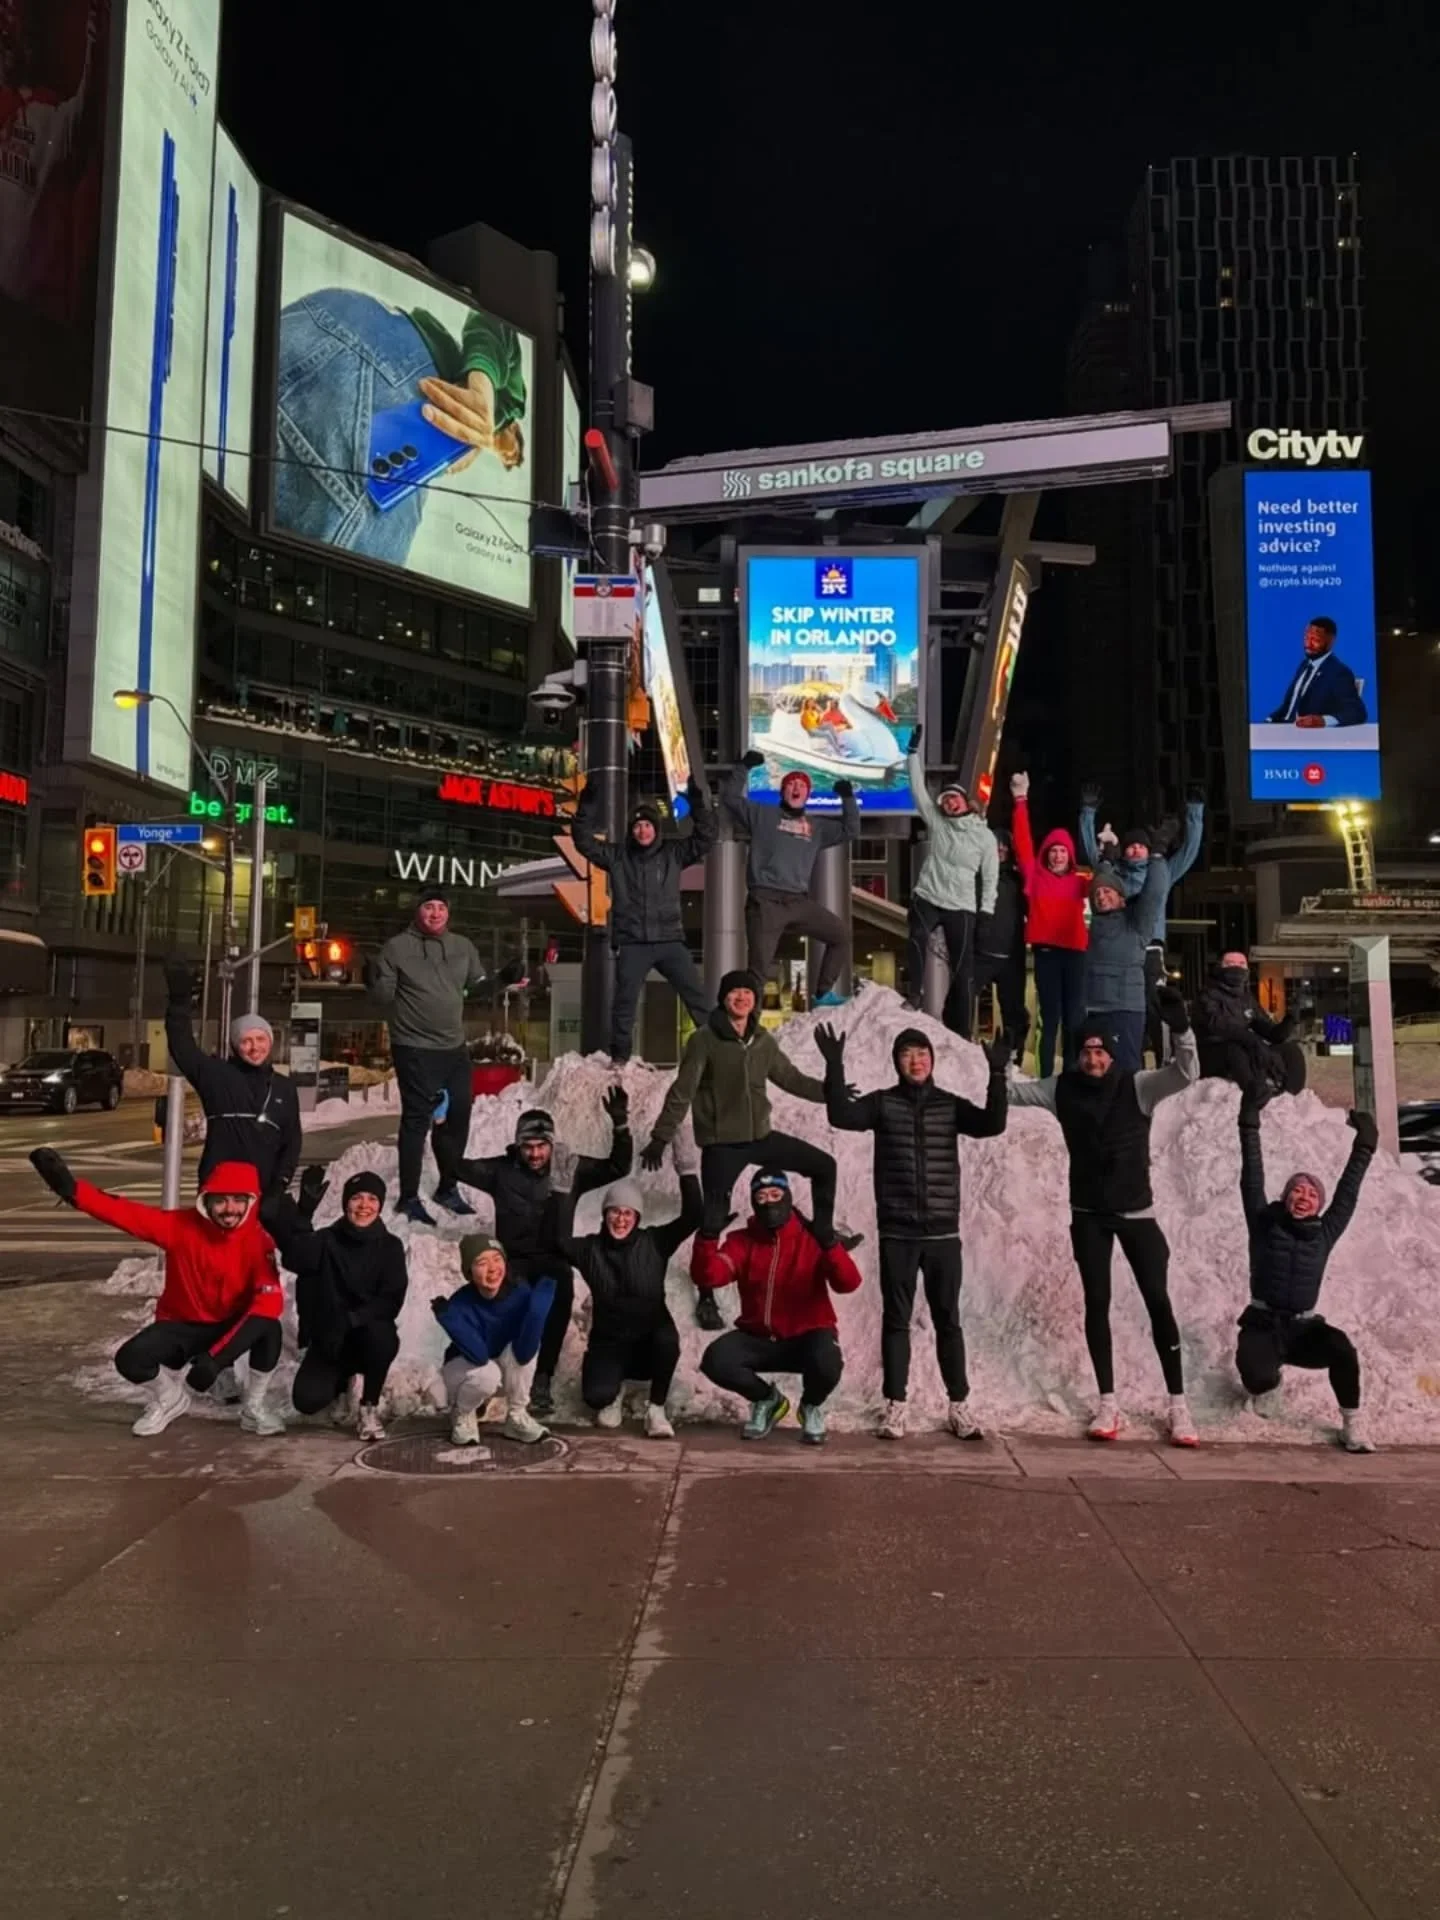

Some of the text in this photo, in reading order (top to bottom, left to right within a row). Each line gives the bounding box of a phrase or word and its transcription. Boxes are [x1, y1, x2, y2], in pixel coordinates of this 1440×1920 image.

[145, 18, 179, 83] Galaxy
[175, 28, 183, 56] Z
[184, 42, 210, 97] Fold7
[1247, 428, 1363, 466] Citytv
[758, 450, 985, 490] sankofa square
[1258, 499, 1358, 515] Need better
[455, 522, 490, 546] Galaxy
[1258, 518, 1336, 537] investing
[1258, 538, 1321, 553] advice?
[1259, 563, 1337, 575] Nothing against
[821, 583, 848, 595] 25°C
[771, 606, 895, 624] SKIP WINTER
[770, 628, 897, 646] IN ORLANDO
[209, 753, 279, 789] DMZ
[1263, 768, 1299, 780] BMO
[190, 791, 295, 825] be grat.
[138, 826, 173, 842] Yonge
[395, 849, 515, 888] WINN
